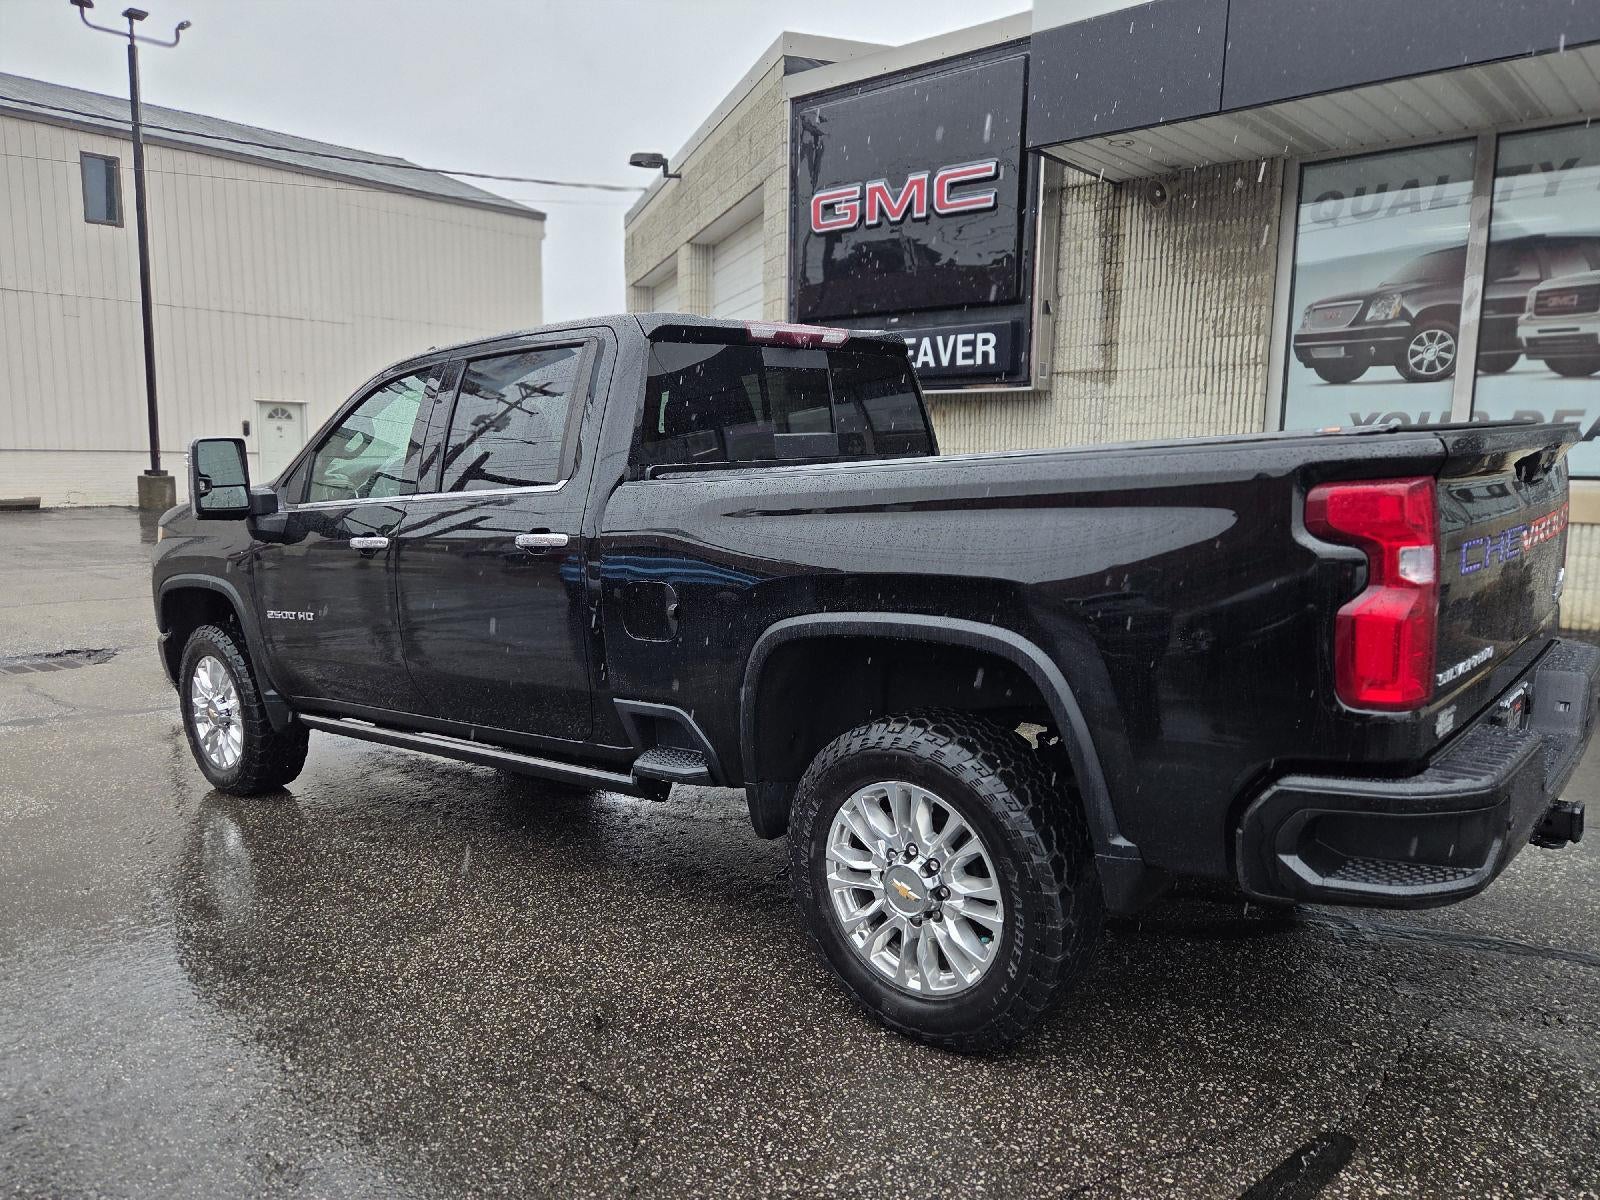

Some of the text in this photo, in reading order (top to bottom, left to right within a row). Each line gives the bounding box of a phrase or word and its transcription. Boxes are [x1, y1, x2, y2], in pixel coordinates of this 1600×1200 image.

[811, 159, 998, 233] GMC
[1310, 157, 1581, 228] QUALTY
[1460, 501, 1569, 576] CHEVRO
[266, 610, 297, 620] 2500
